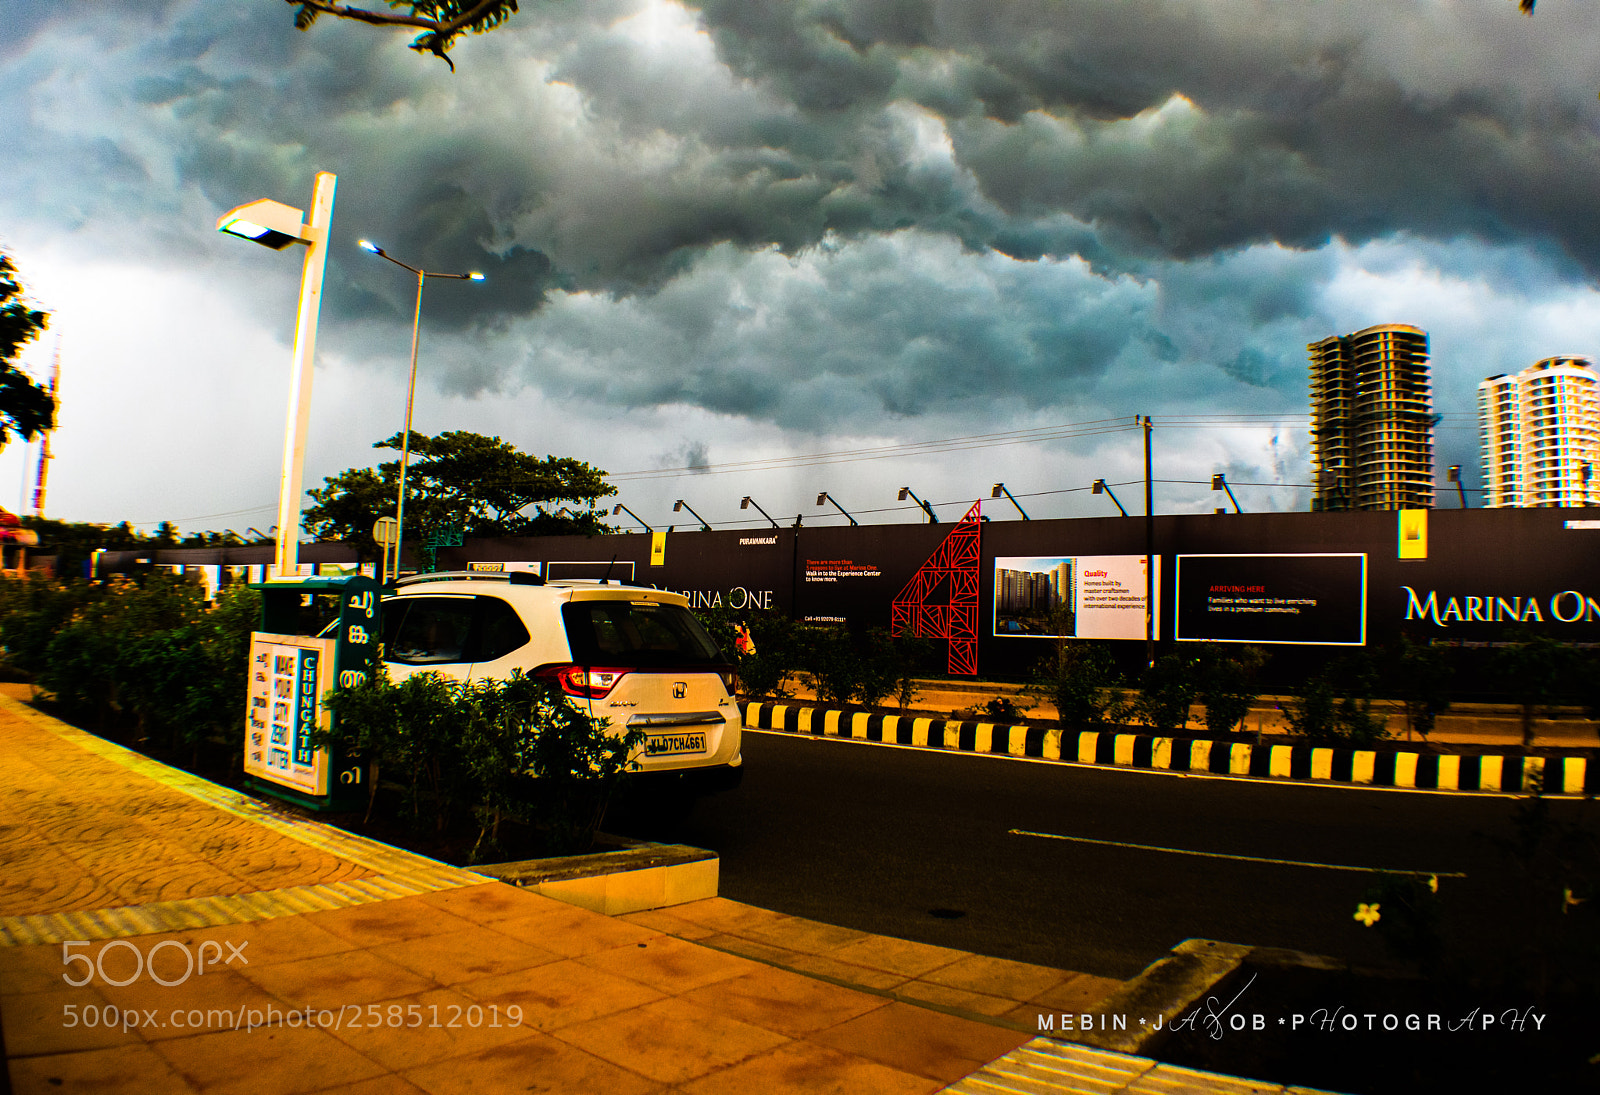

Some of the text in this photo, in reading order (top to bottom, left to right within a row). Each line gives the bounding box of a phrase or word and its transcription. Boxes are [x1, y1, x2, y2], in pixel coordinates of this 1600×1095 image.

[739, 536, 776, 545] PURAVANKARA
[1084, 570, 1108, 578] Quality
[729, 586, 773, 610] ONE
[1286, 598, 1317, 606] enriching
[1400, 586, 1544, 628] MARINA
[298, 658, 316, 762] CHUNGATH
[651, 736, 705, 752] KL07CH4661
